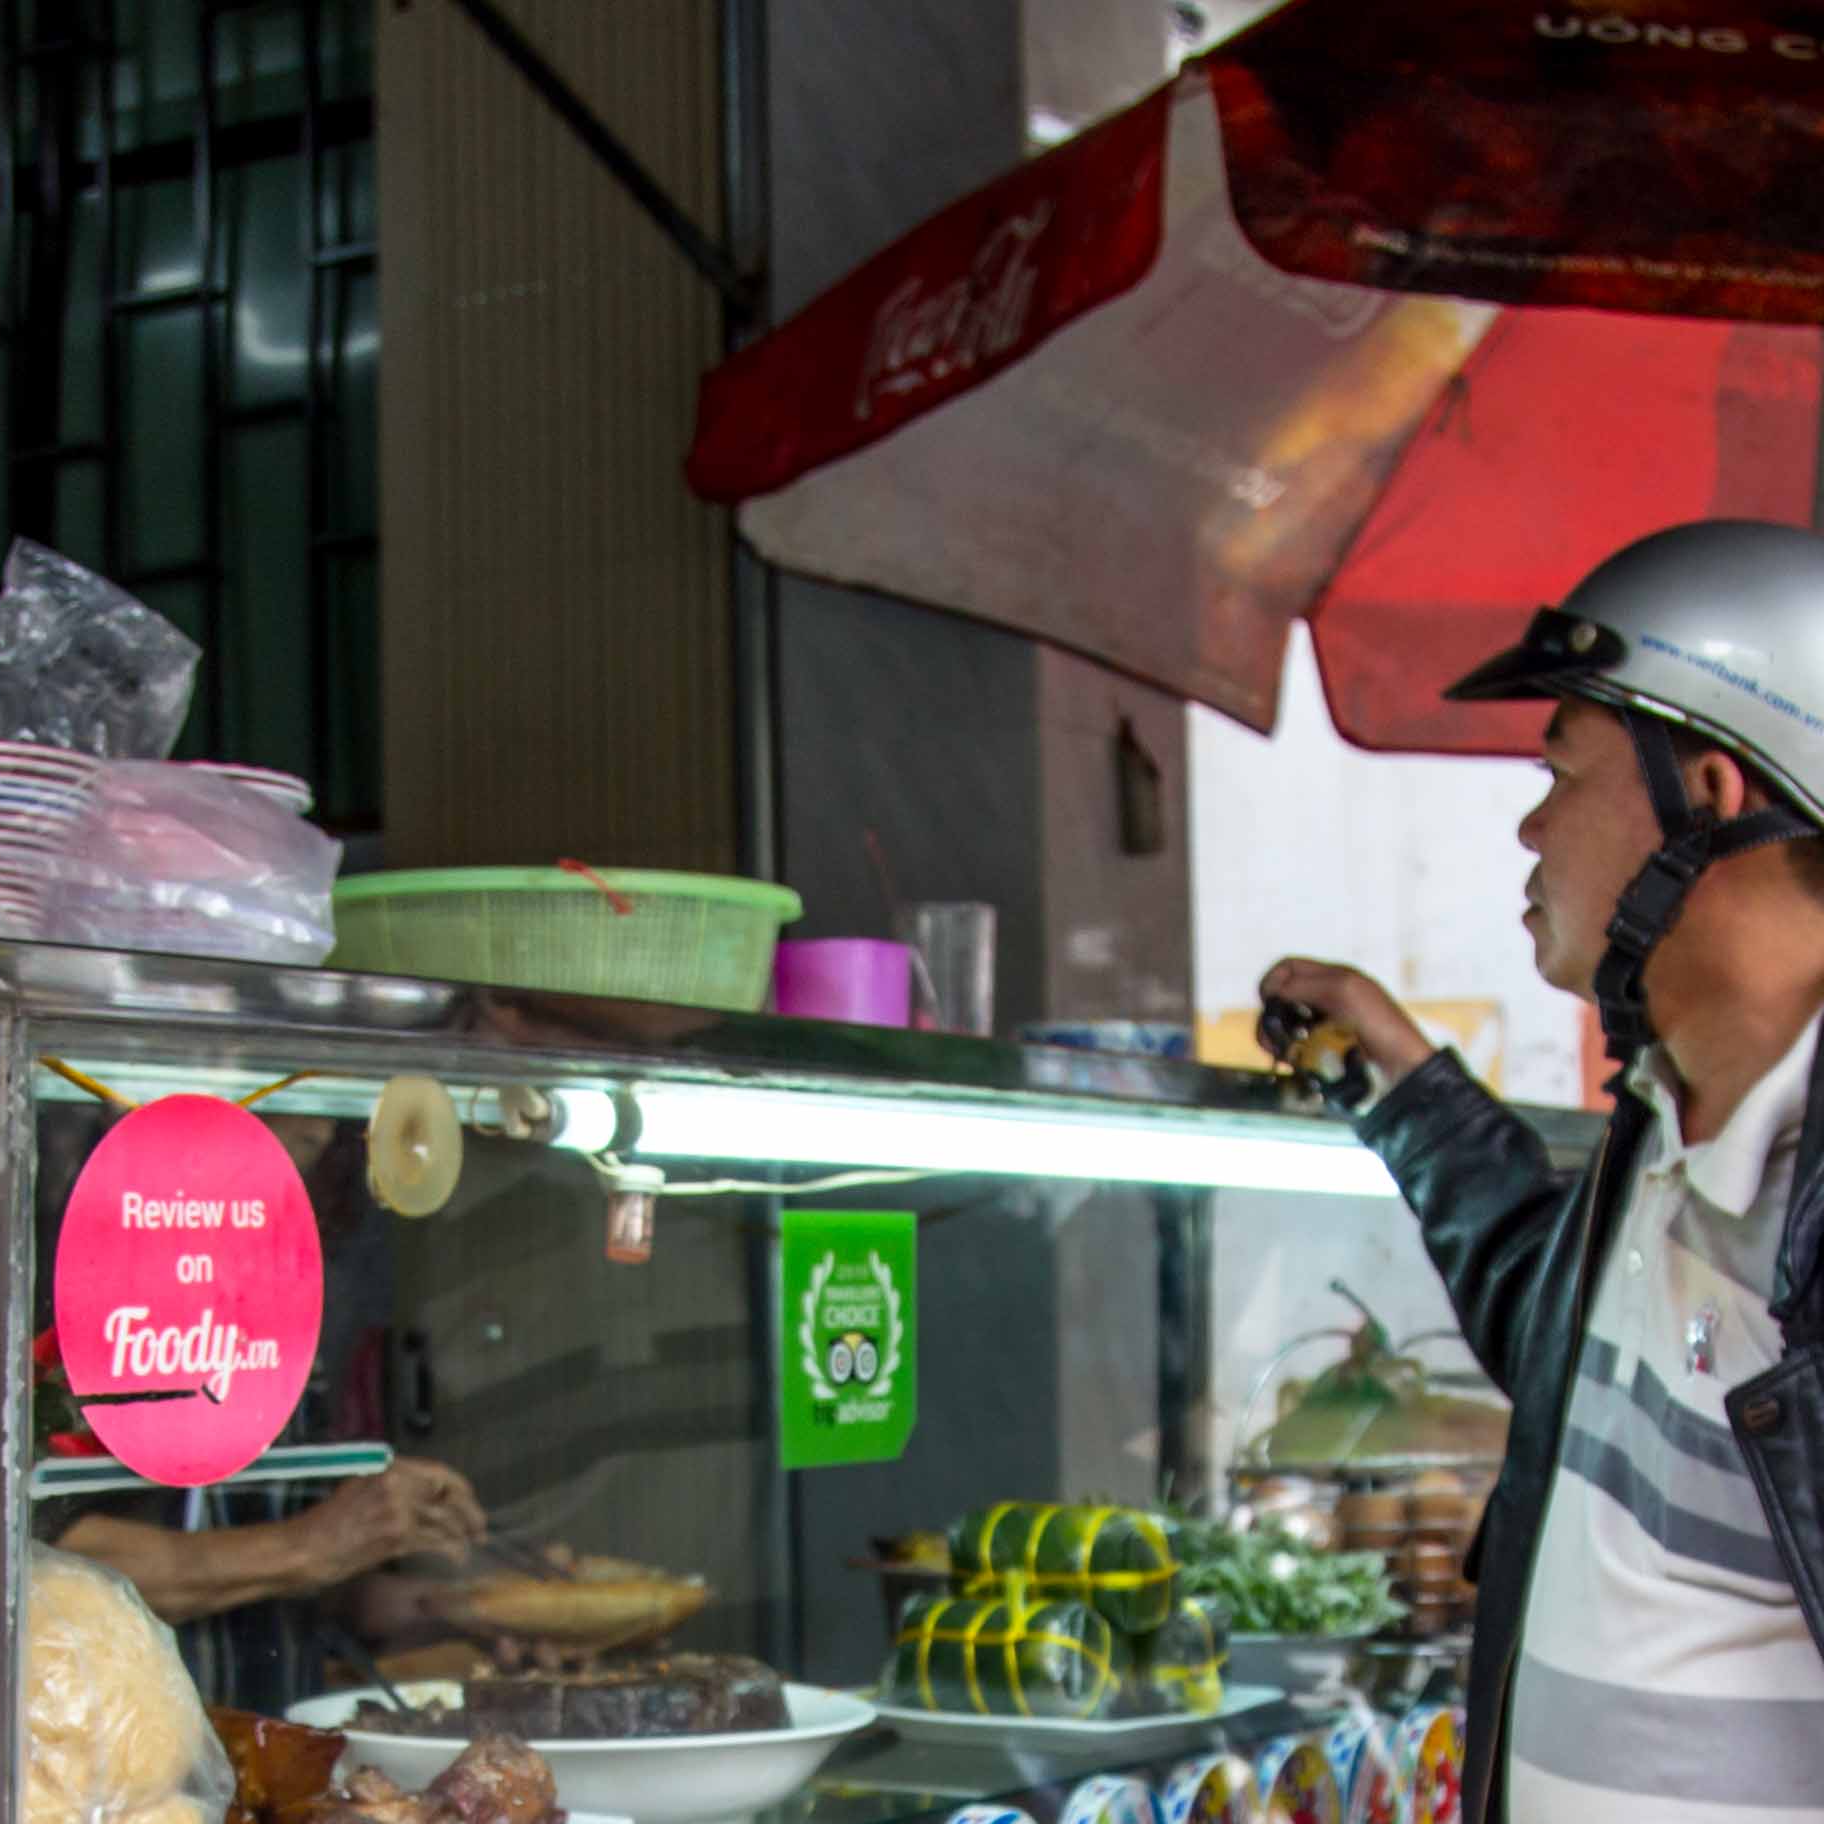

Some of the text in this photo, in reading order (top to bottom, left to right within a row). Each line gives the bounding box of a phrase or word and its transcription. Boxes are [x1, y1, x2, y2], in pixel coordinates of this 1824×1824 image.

[121, 1188, 266, 1229] Review us
[176, 1253, 214, 1284] on
